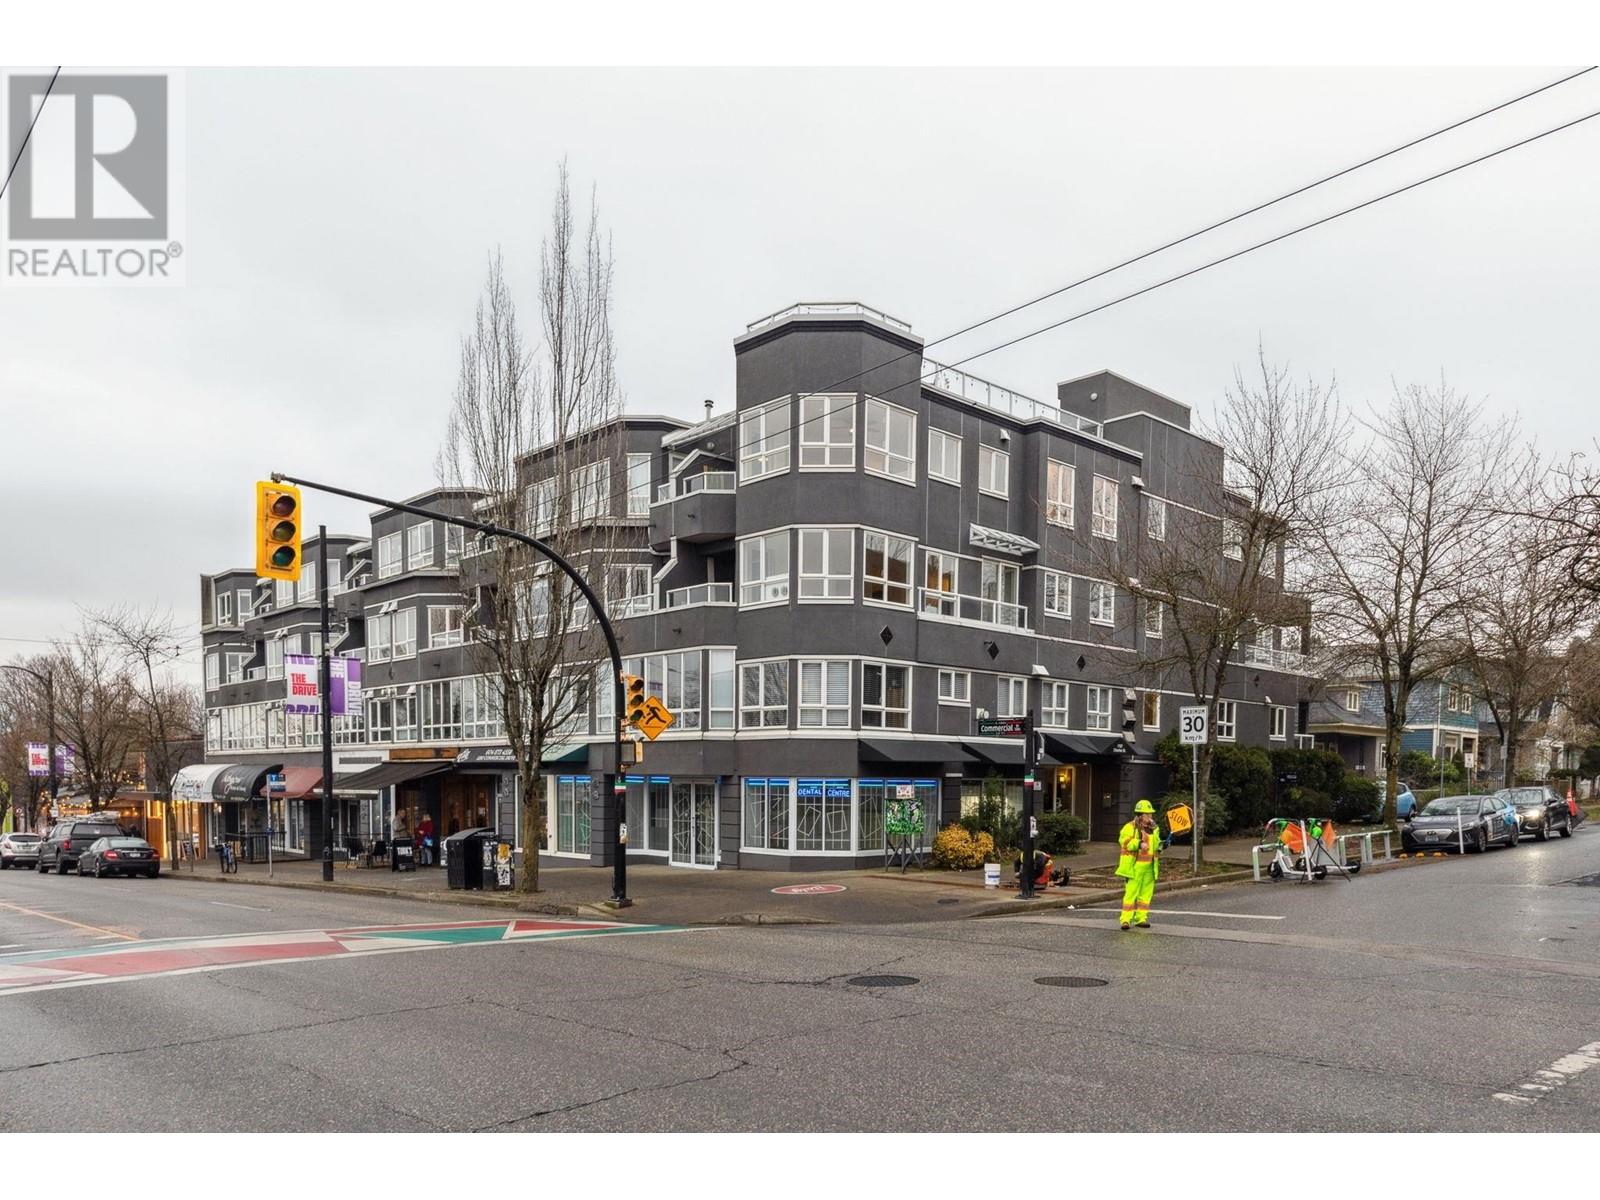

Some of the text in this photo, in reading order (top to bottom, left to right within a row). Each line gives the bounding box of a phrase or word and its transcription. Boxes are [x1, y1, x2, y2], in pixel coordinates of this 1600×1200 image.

[290, 673, 306, 683] THE
[292, 685, 317, 696] DRIVE
[980, 724, 1014, 732] Commercial
[1183, 715, 1205, 733] 30
[827, 789, 850, 797] CENTRE
[1169, 811, 1188, 827] SLOW
